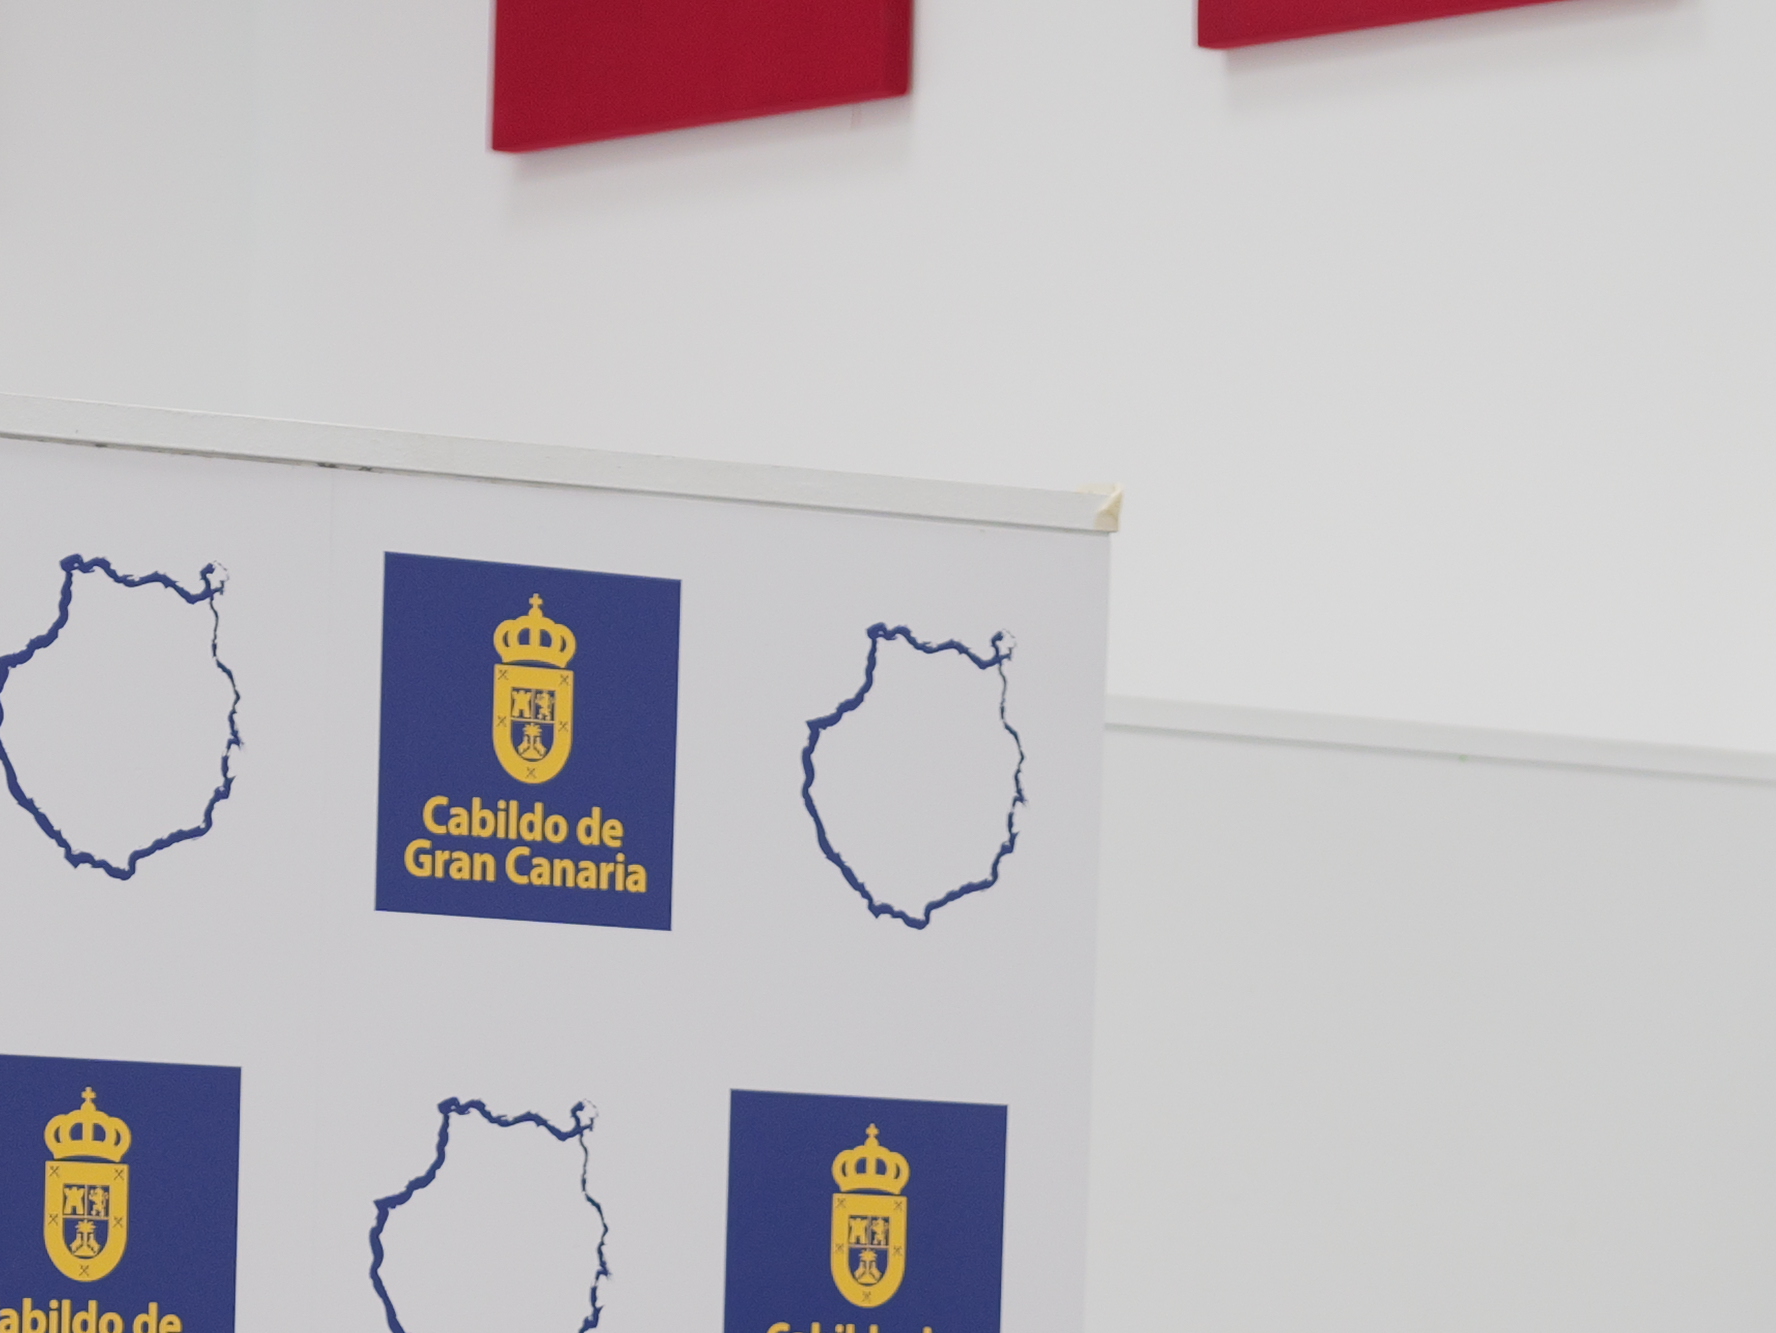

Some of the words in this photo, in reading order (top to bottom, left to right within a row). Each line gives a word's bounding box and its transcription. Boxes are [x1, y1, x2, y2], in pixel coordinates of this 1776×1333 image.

[424, 796, 568, 842] Cabildo
[578, 807, 624, 847] de
[406, 840, 496, 881] Gran
[507, 847, 647, 892] Canaria
